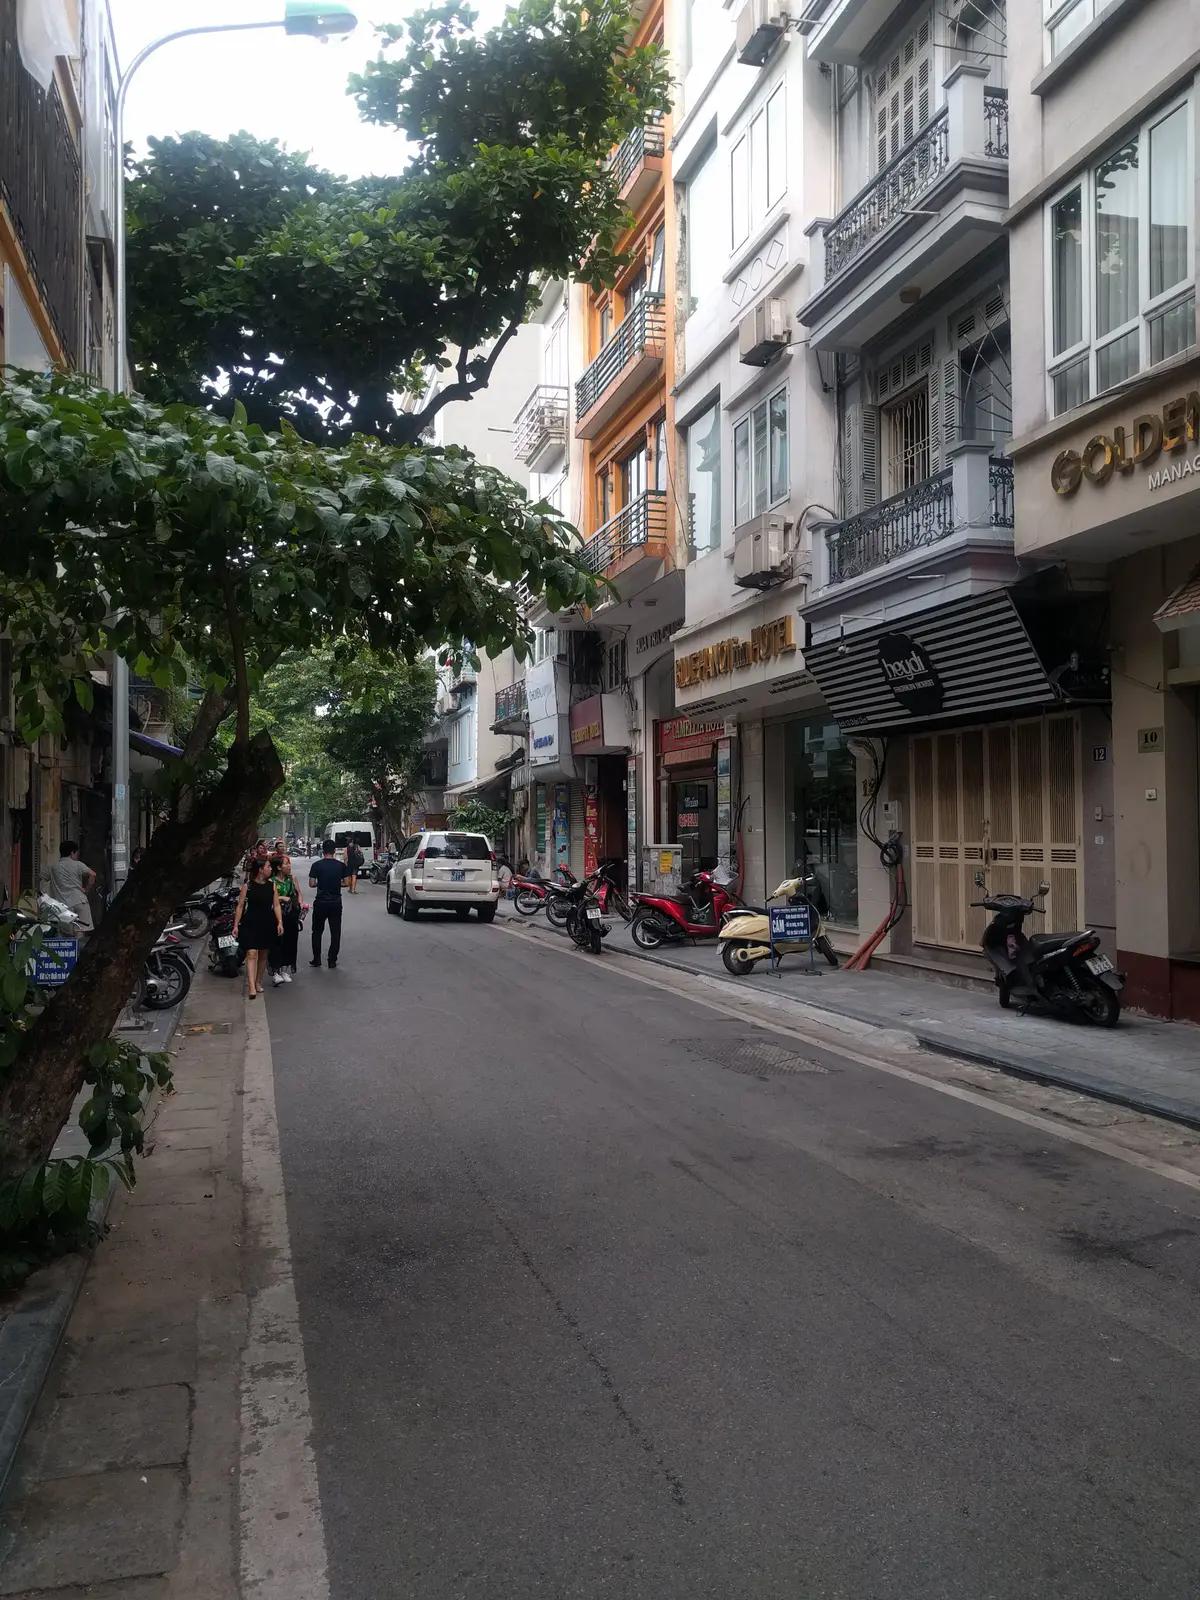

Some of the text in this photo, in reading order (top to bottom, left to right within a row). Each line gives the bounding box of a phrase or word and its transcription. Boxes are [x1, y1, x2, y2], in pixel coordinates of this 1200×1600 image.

[882, 651, 926, 680] heydi
[1144, 731, 1158, 744] 10
[1095, 748, 1105, 761] 12
